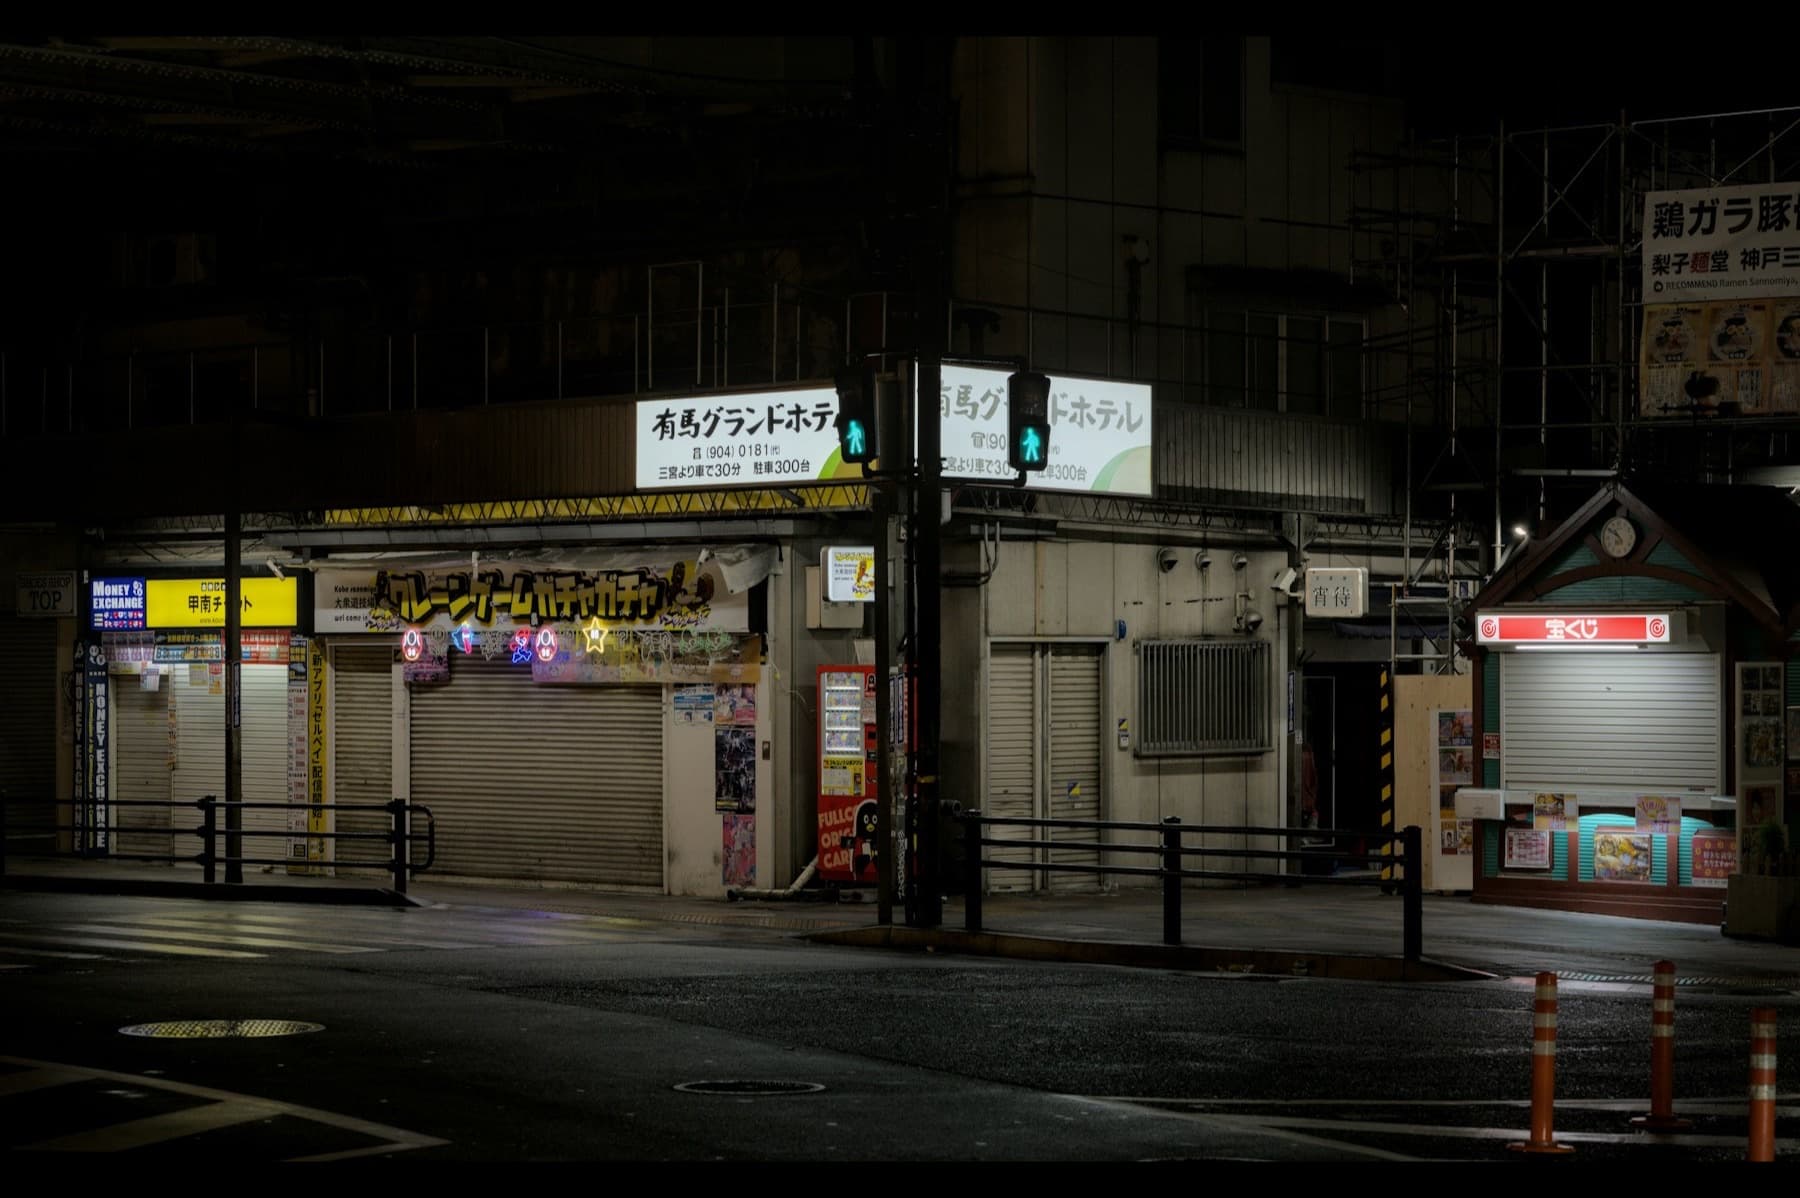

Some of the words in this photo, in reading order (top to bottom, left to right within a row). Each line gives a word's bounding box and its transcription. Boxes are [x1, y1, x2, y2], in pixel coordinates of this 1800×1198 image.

[1652, 195, 1800, 240] 鶏ガラ豚
[1719, 278, 1747, 288] Ramen
[652, 402, 840, 440] 有馬グランドホテ
[658, 461, 741, 480] 三宮より車で30分
[753, 459, 810, 474] 駐車300台
[30, 591, 62, 609] TOP
[93, 597, 143, 608] EXCHANGE
[188, 595, 253, 613] 甲南チト
[1545, 619, 1598, 639] 宝くじ
[96, 683, 105, 747] MONEY
